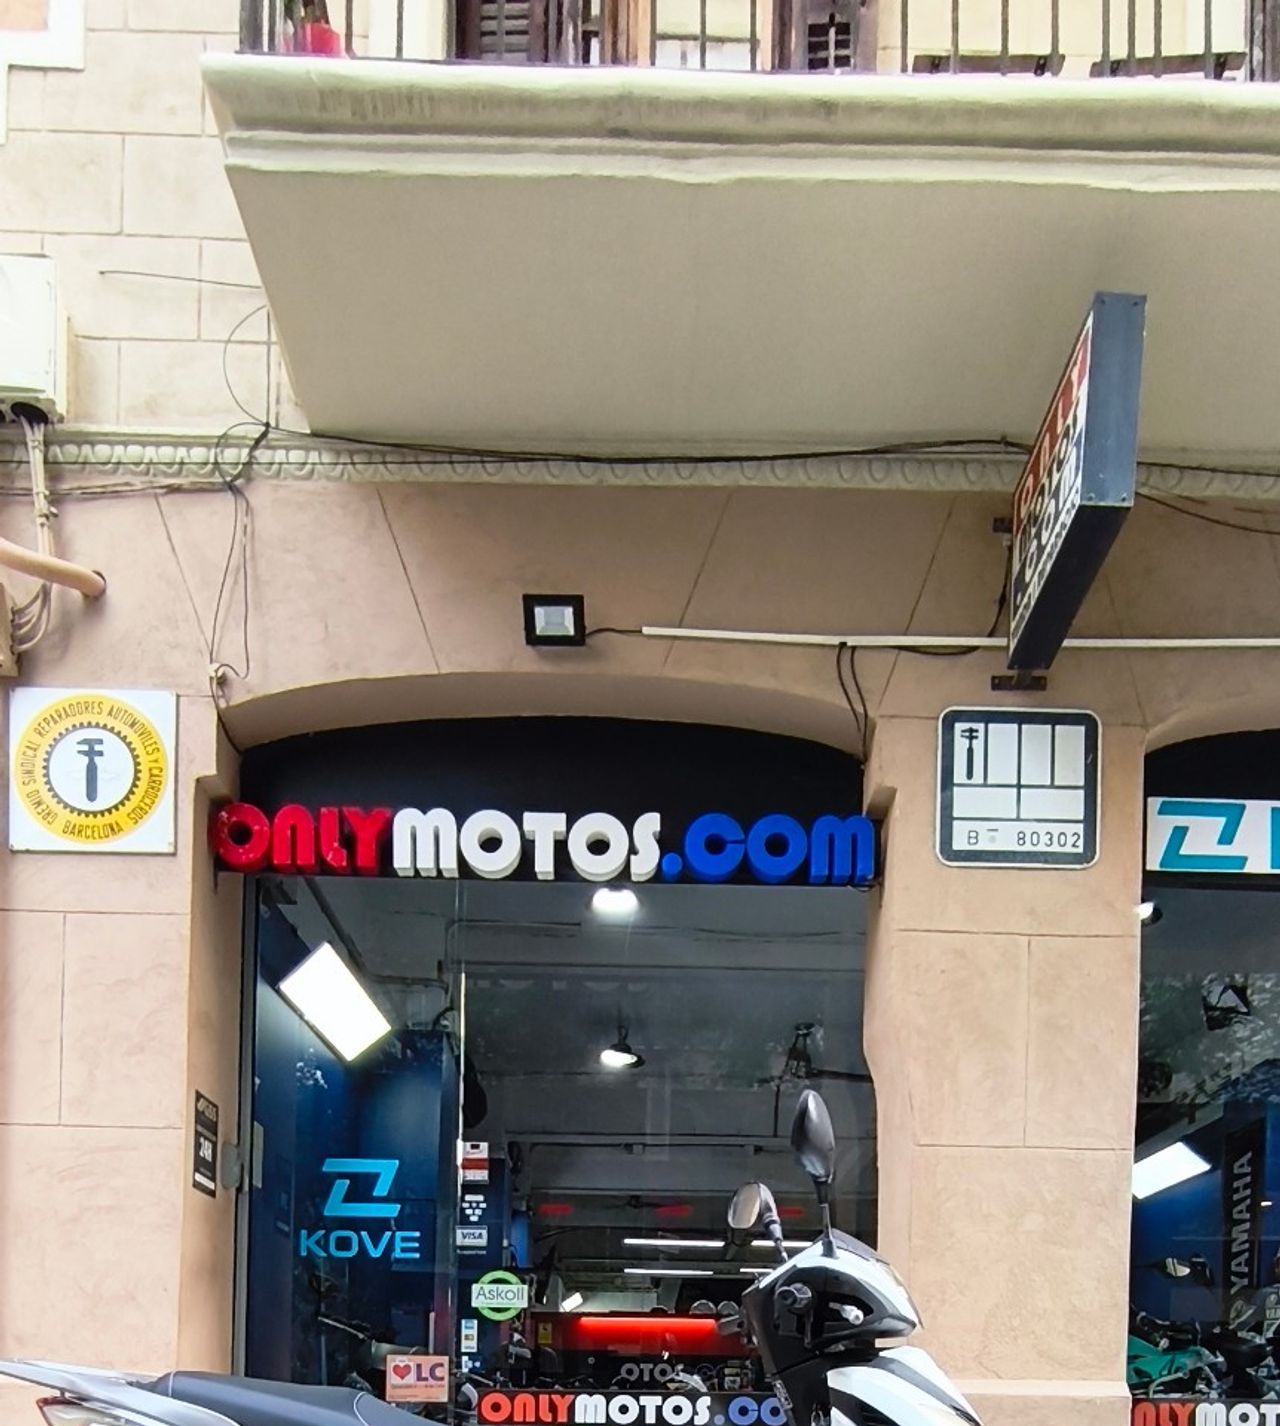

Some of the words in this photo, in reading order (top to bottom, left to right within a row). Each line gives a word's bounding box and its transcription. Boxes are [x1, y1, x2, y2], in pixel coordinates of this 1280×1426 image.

[35, 701, 104, 739] REPARADORES
[107, 705, 160, 755] AUTOMOVILES
[20, 740, 40, 786] SINDICAL
[26, 789, 58, 825] GREMIO
[127, 766, 163, 825] CARROCEROS
[62, 821, 124, 840] BARCELONA
[211, 803, 876, 882] ONLYMOTOS.COM
[967, 830, 979, 846] B
[1016, 831, 1081, 848] 80302
[461, 1231, 484, 1242] VISA
[1230, 1151, 1253, 1295] YAMAHA
[300, 1230, 421, 1258] KOVE
[475, 1286, 524, 1302] Askoll
[416, 1362, 445, 1382] LC
[481, 1392, 787, 1426] ONLYMOTOS.CO
